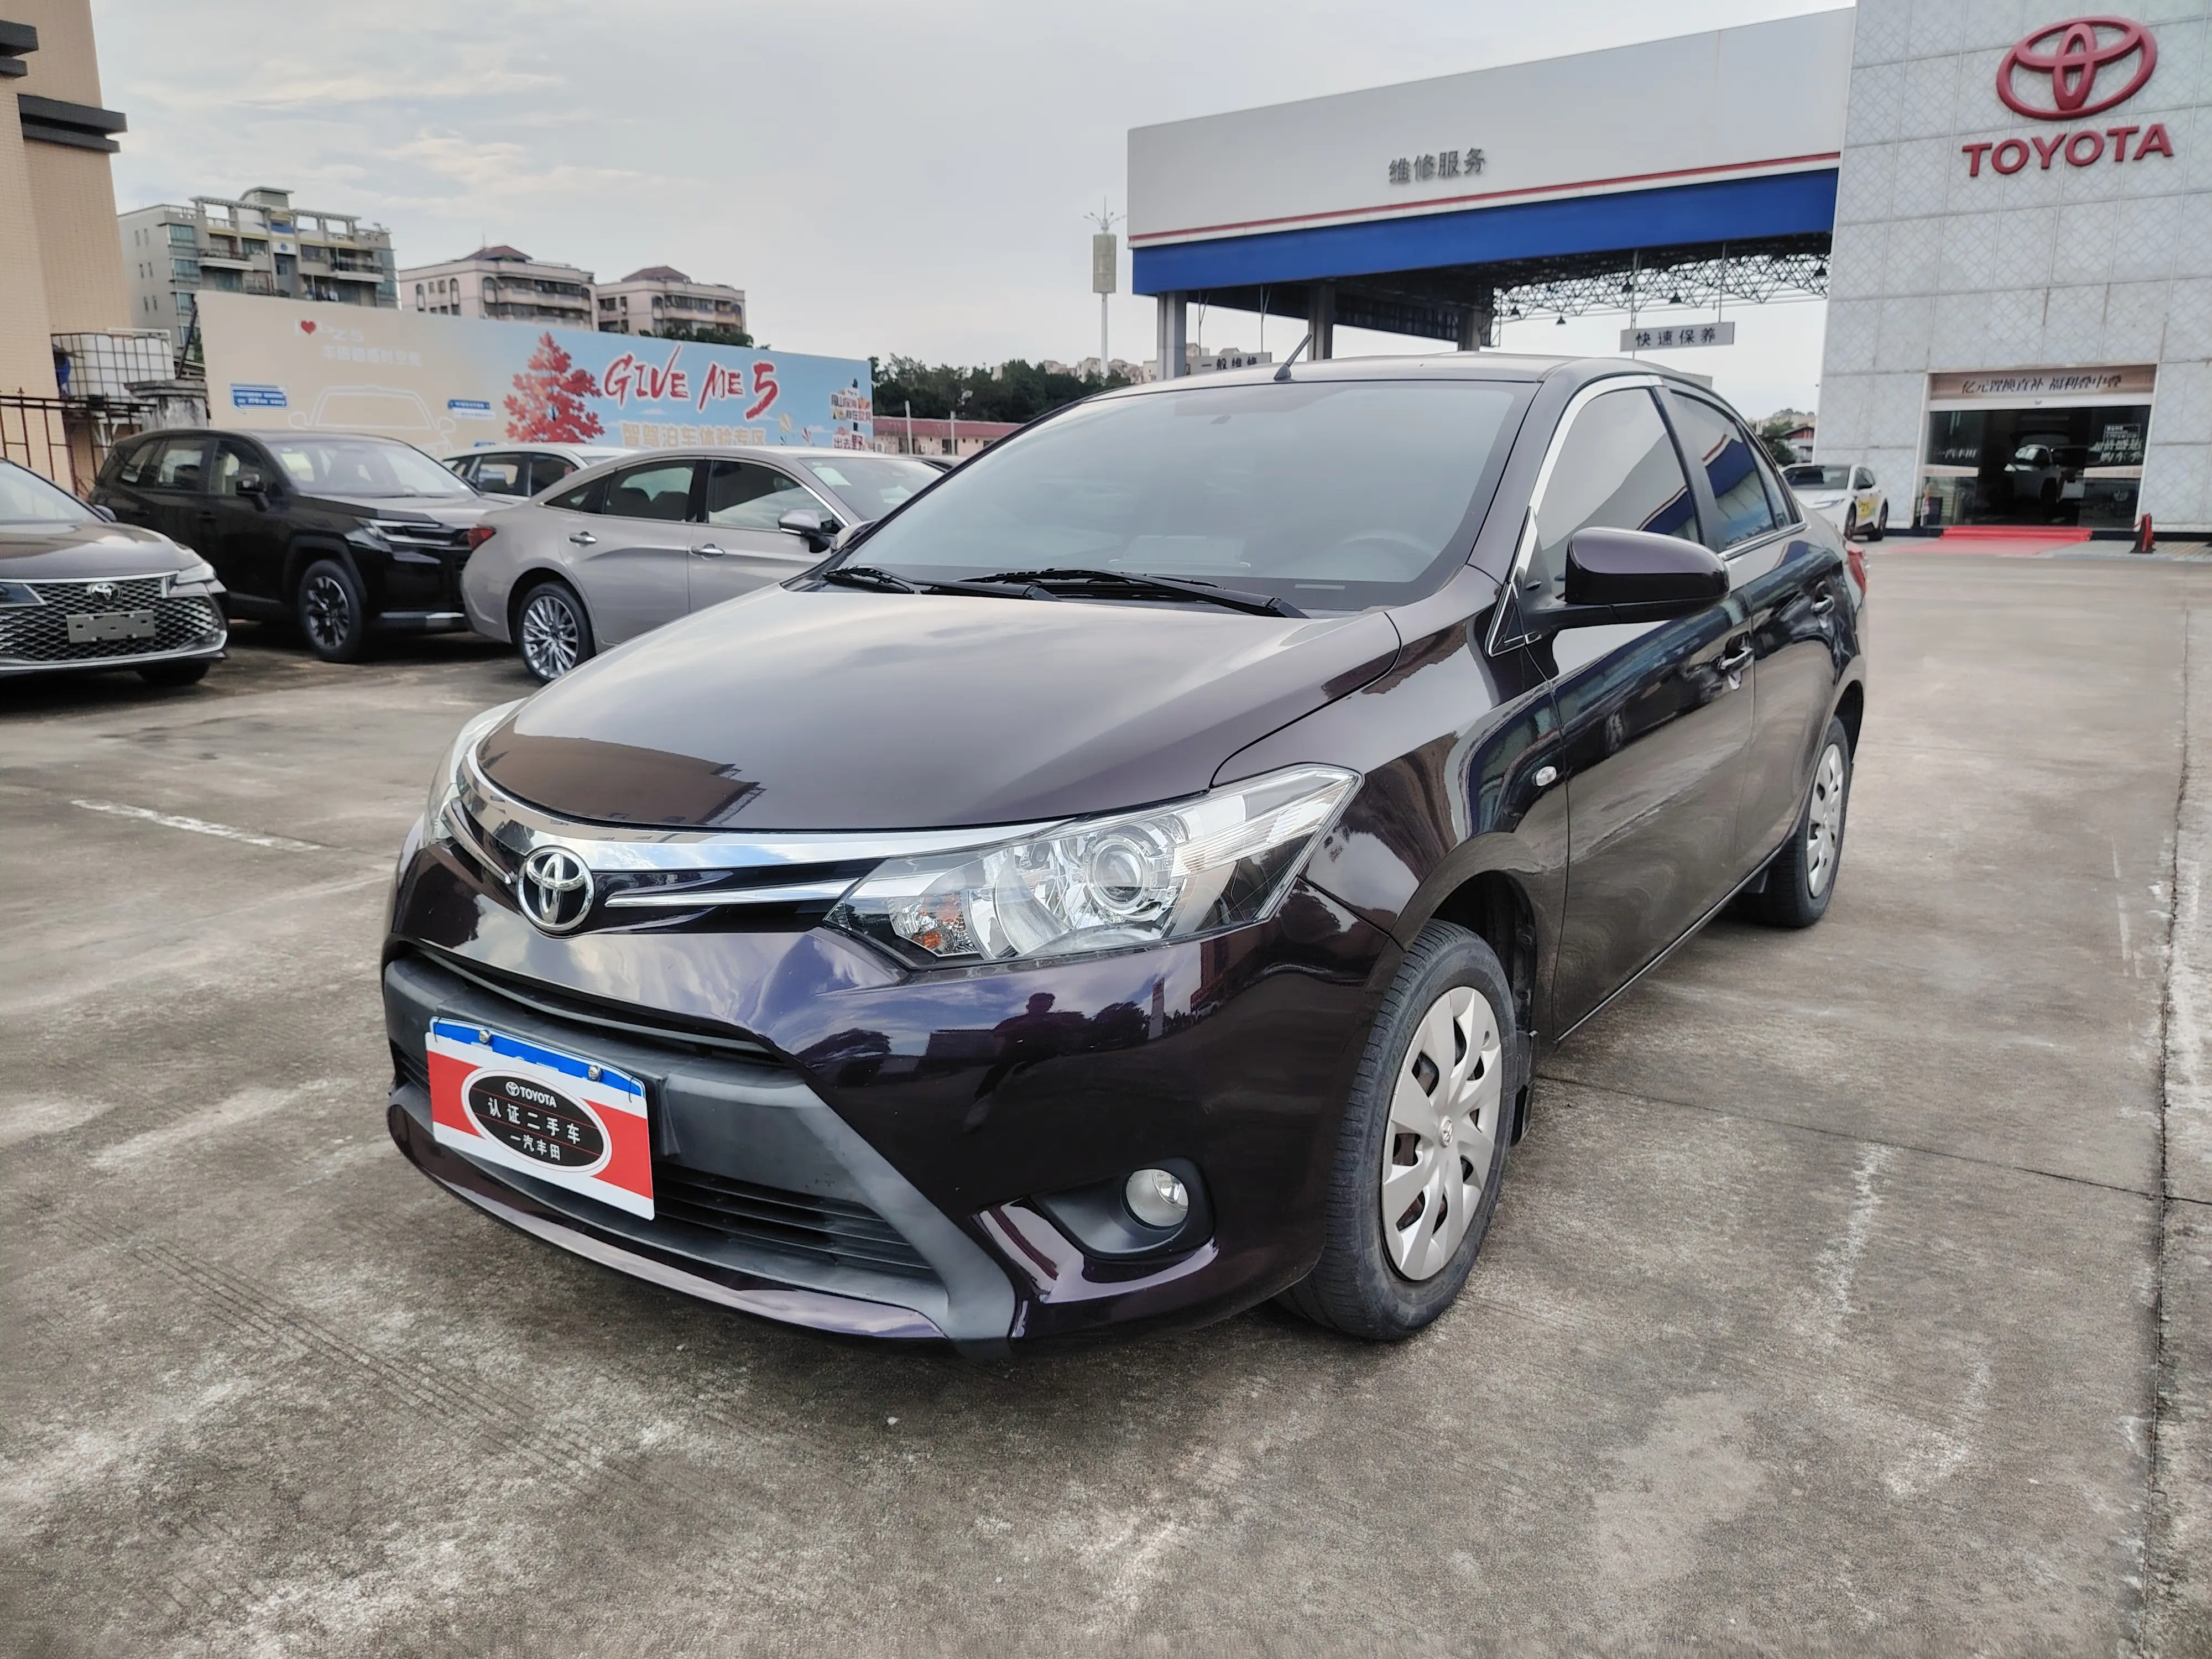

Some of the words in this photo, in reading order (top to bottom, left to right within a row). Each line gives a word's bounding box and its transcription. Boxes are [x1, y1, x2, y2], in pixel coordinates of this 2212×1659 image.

[1962, 122, 2174, 177] TOYOTA
[1389, 147, 1486, 185] 维修服务
[1635, 327, 1715, 347] 快速保养
[1201, 355, 1257, 371] 一般维修
[604, 345, 690, 407] GIVE
[698, 362, 745, 411] ME
[745, 362, 779, 420] 5
[623, 422, 766, 447] 智驾泊车体验专区
[520, 1087, 557, 1109] TOYOTA
[487, 1097, 581, 1145] 认证二手车
[510, 1134, 561, 1161] 一汽丰田
